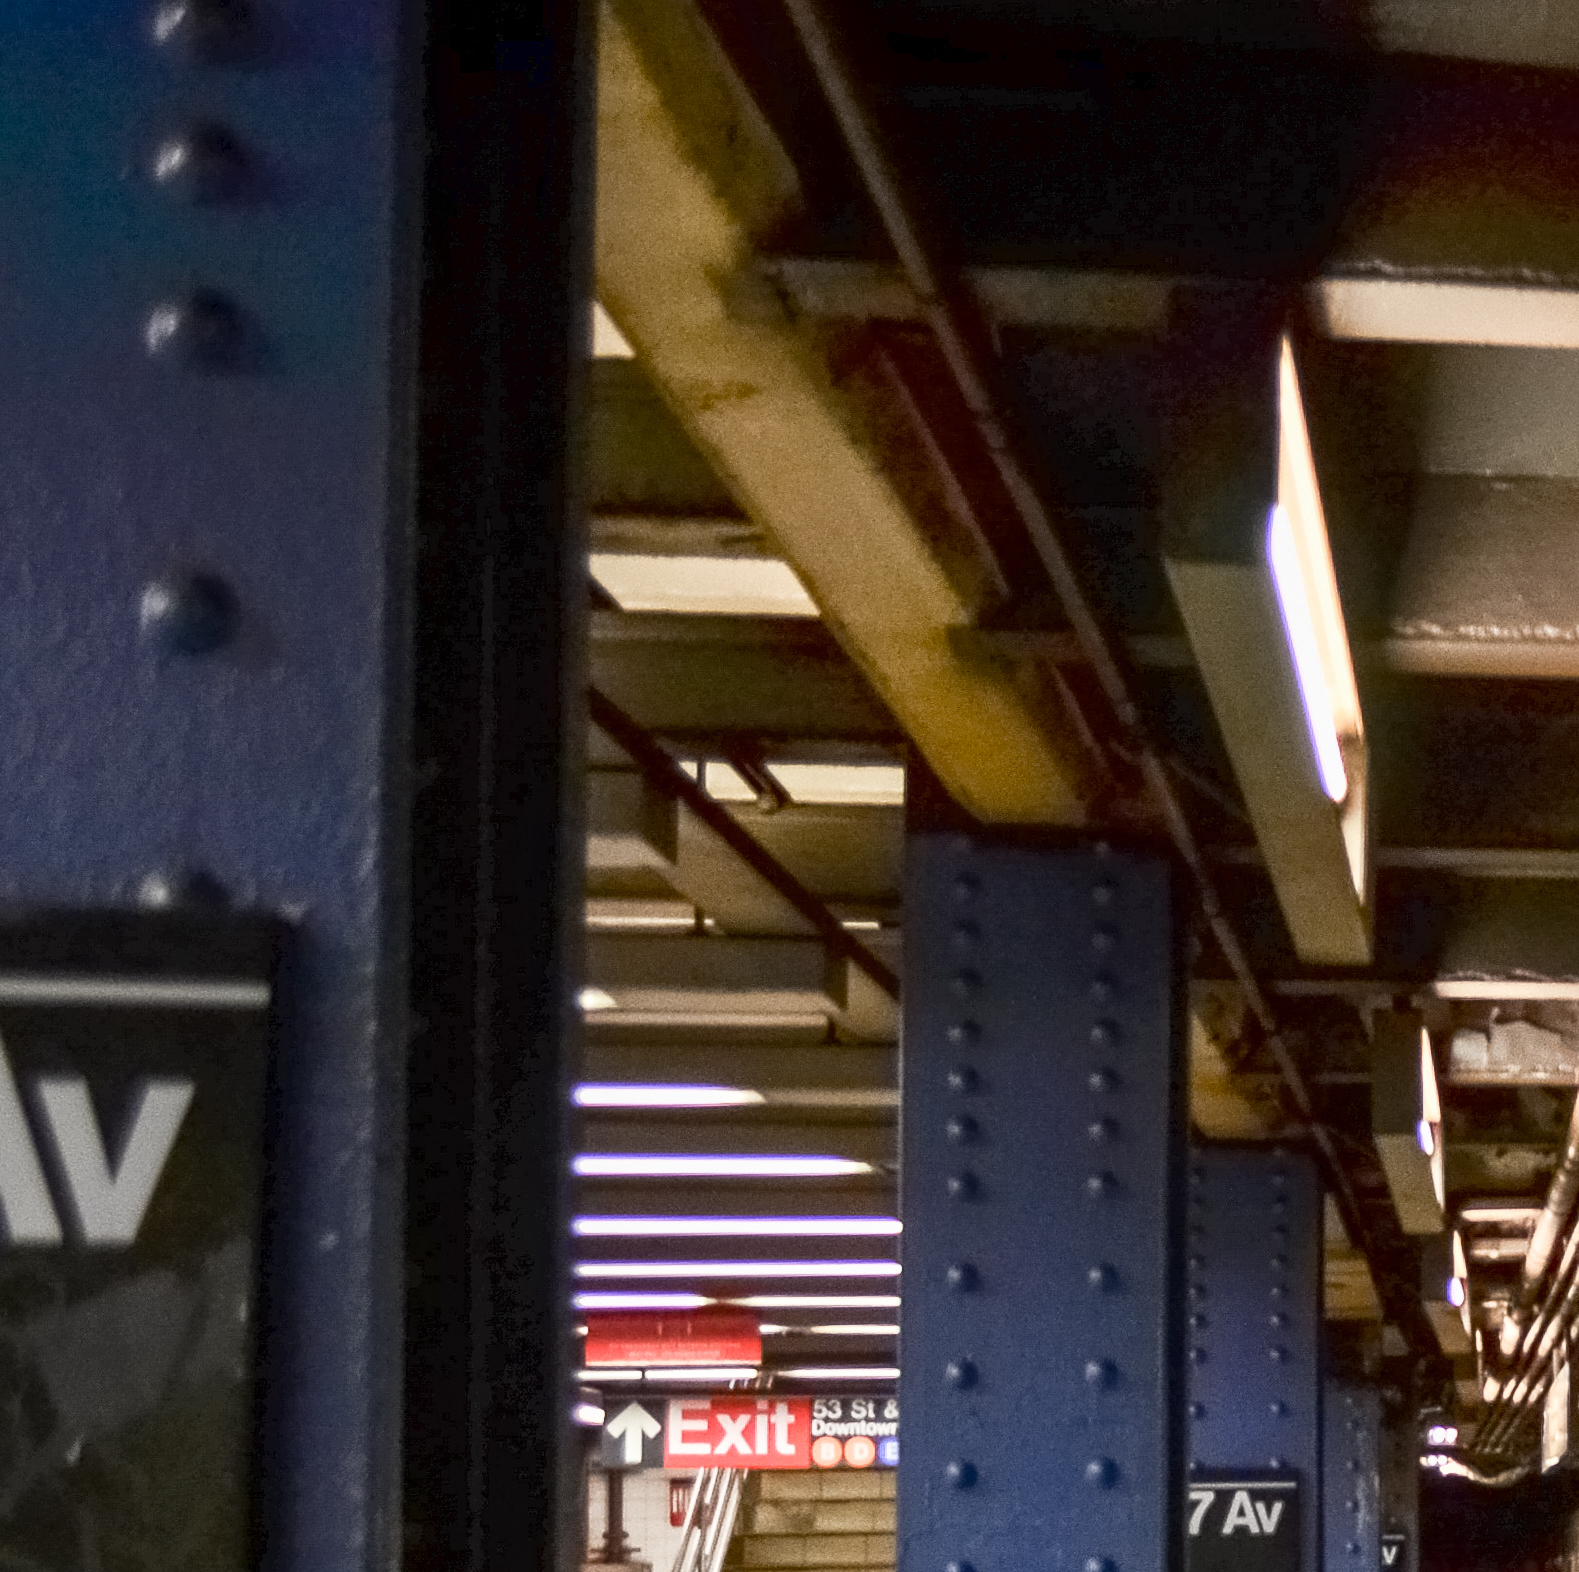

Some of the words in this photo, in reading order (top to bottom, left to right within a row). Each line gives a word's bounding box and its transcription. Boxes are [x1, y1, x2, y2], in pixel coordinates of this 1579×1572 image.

[813, 1399, 842, 1419] 53
[851, 1399, 875, 1419] St
[884, 1399, 899, 1418] &
[669, 1399, 796, 1455] Exit
[821, 1442, 834, 1460] B
[854, 1442, 869, 1460] D
[885, 1441, 899, 1460] E
[1188, 1491, 1216, 1535] 7
[1223, 1490, 1283, 1535] Av
